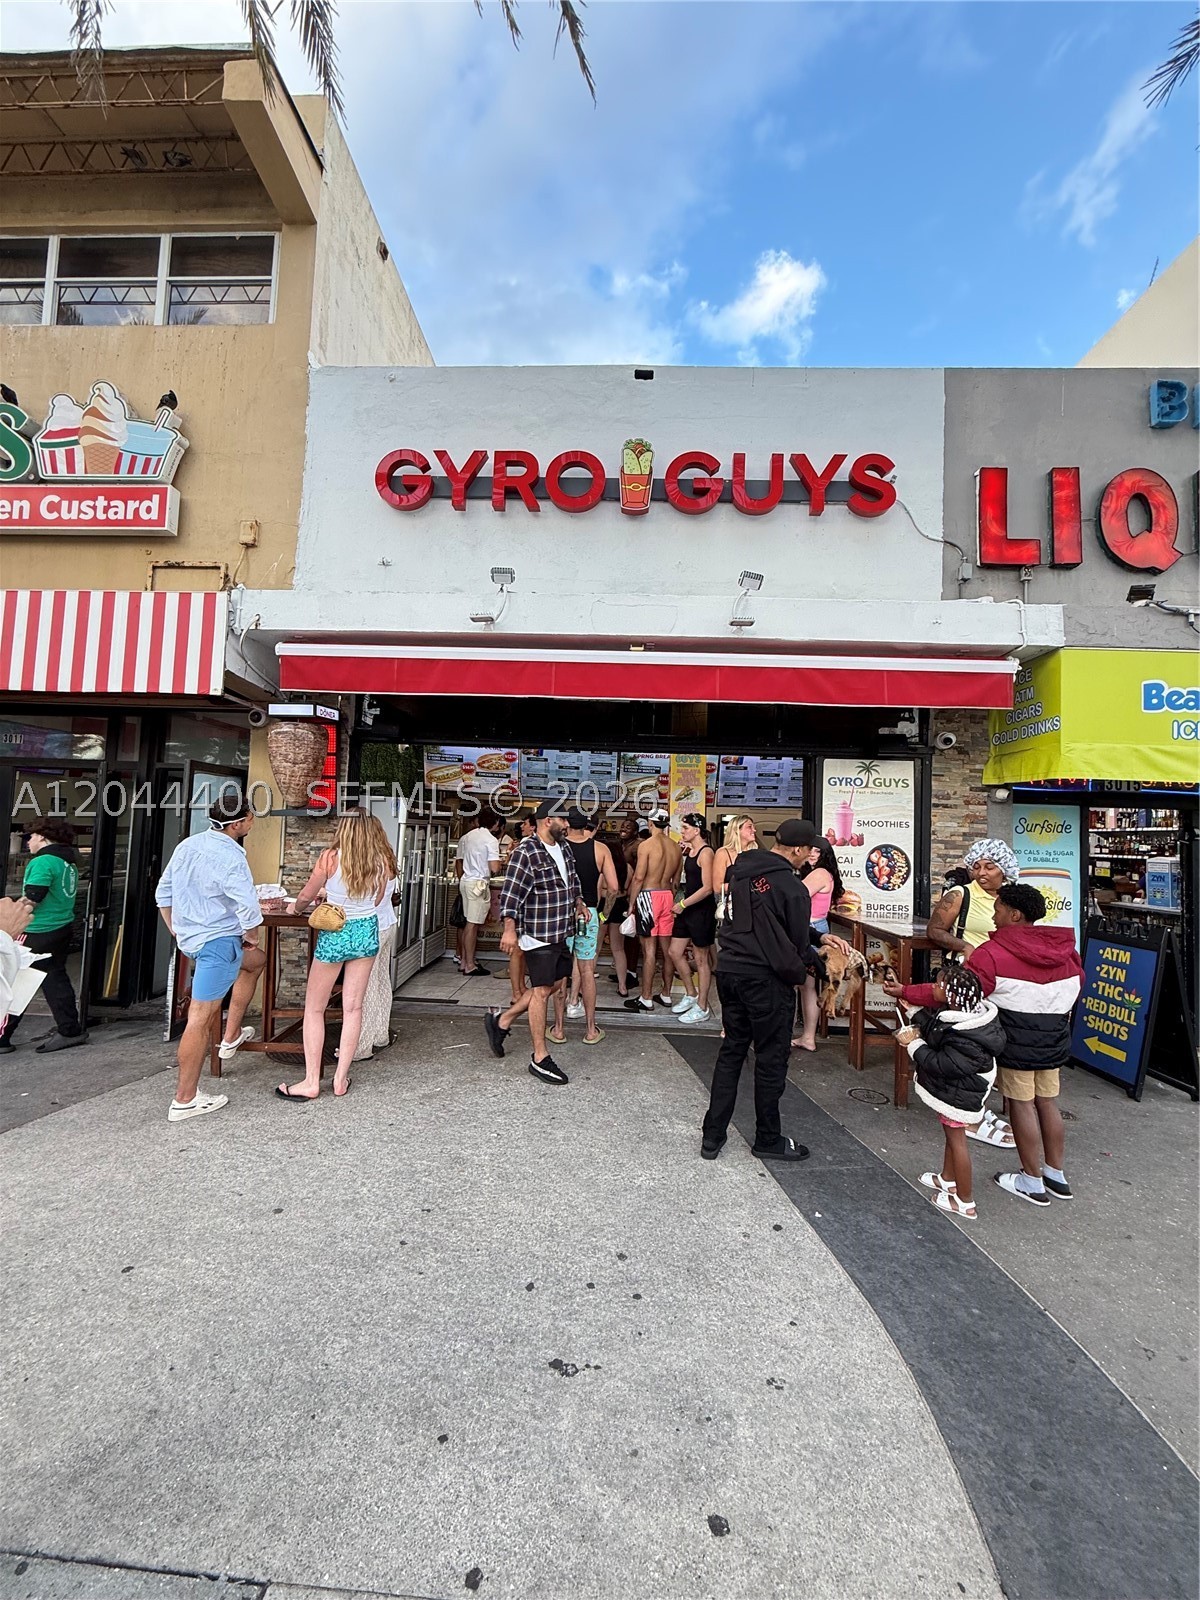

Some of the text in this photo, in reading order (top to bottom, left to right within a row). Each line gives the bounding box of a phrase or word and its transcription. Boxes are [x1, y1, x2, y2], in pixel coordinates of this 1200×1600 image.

[1149, 380, 1200, 429] B
[375, 448, 897, 518] GYRO GUYS
[39, 494, 160, 520] Custard
[974, 467, 1200, 575] LIQ
[1014, 686, 1034, 703] ATM
[320, 708, 336, 718] DÖNER
[1006, 703, 1042, 724] CIGARS
[3, 733, 23, 744] 3011
[993, 717, 1060, 745] COLD DRINKS
[1172, 720, 1200, 740] IC
[828, 777, 909, 788] GYRO GUYS
[1105, 780, 1141, 791] 3015
[857, 820, 910, 829] SMOOTHIES
[1015, 818, 1072, 835] Surfside
[840, 870, 861, 878] WLS
[866, 904, 909, 912] BURGERS
[1044, 897, 1072, 911] fside
[866, 941, 881, 949] ERS
[1103, 948, 1130, 964] ATM
[1100, 964, 1126, 982] ZYN
[1097, 981, 1123, 1001] THC
[1086, 997, 1136, 1025] RED BULL
[1087, 1015, 1128, 1041] SHOTS
